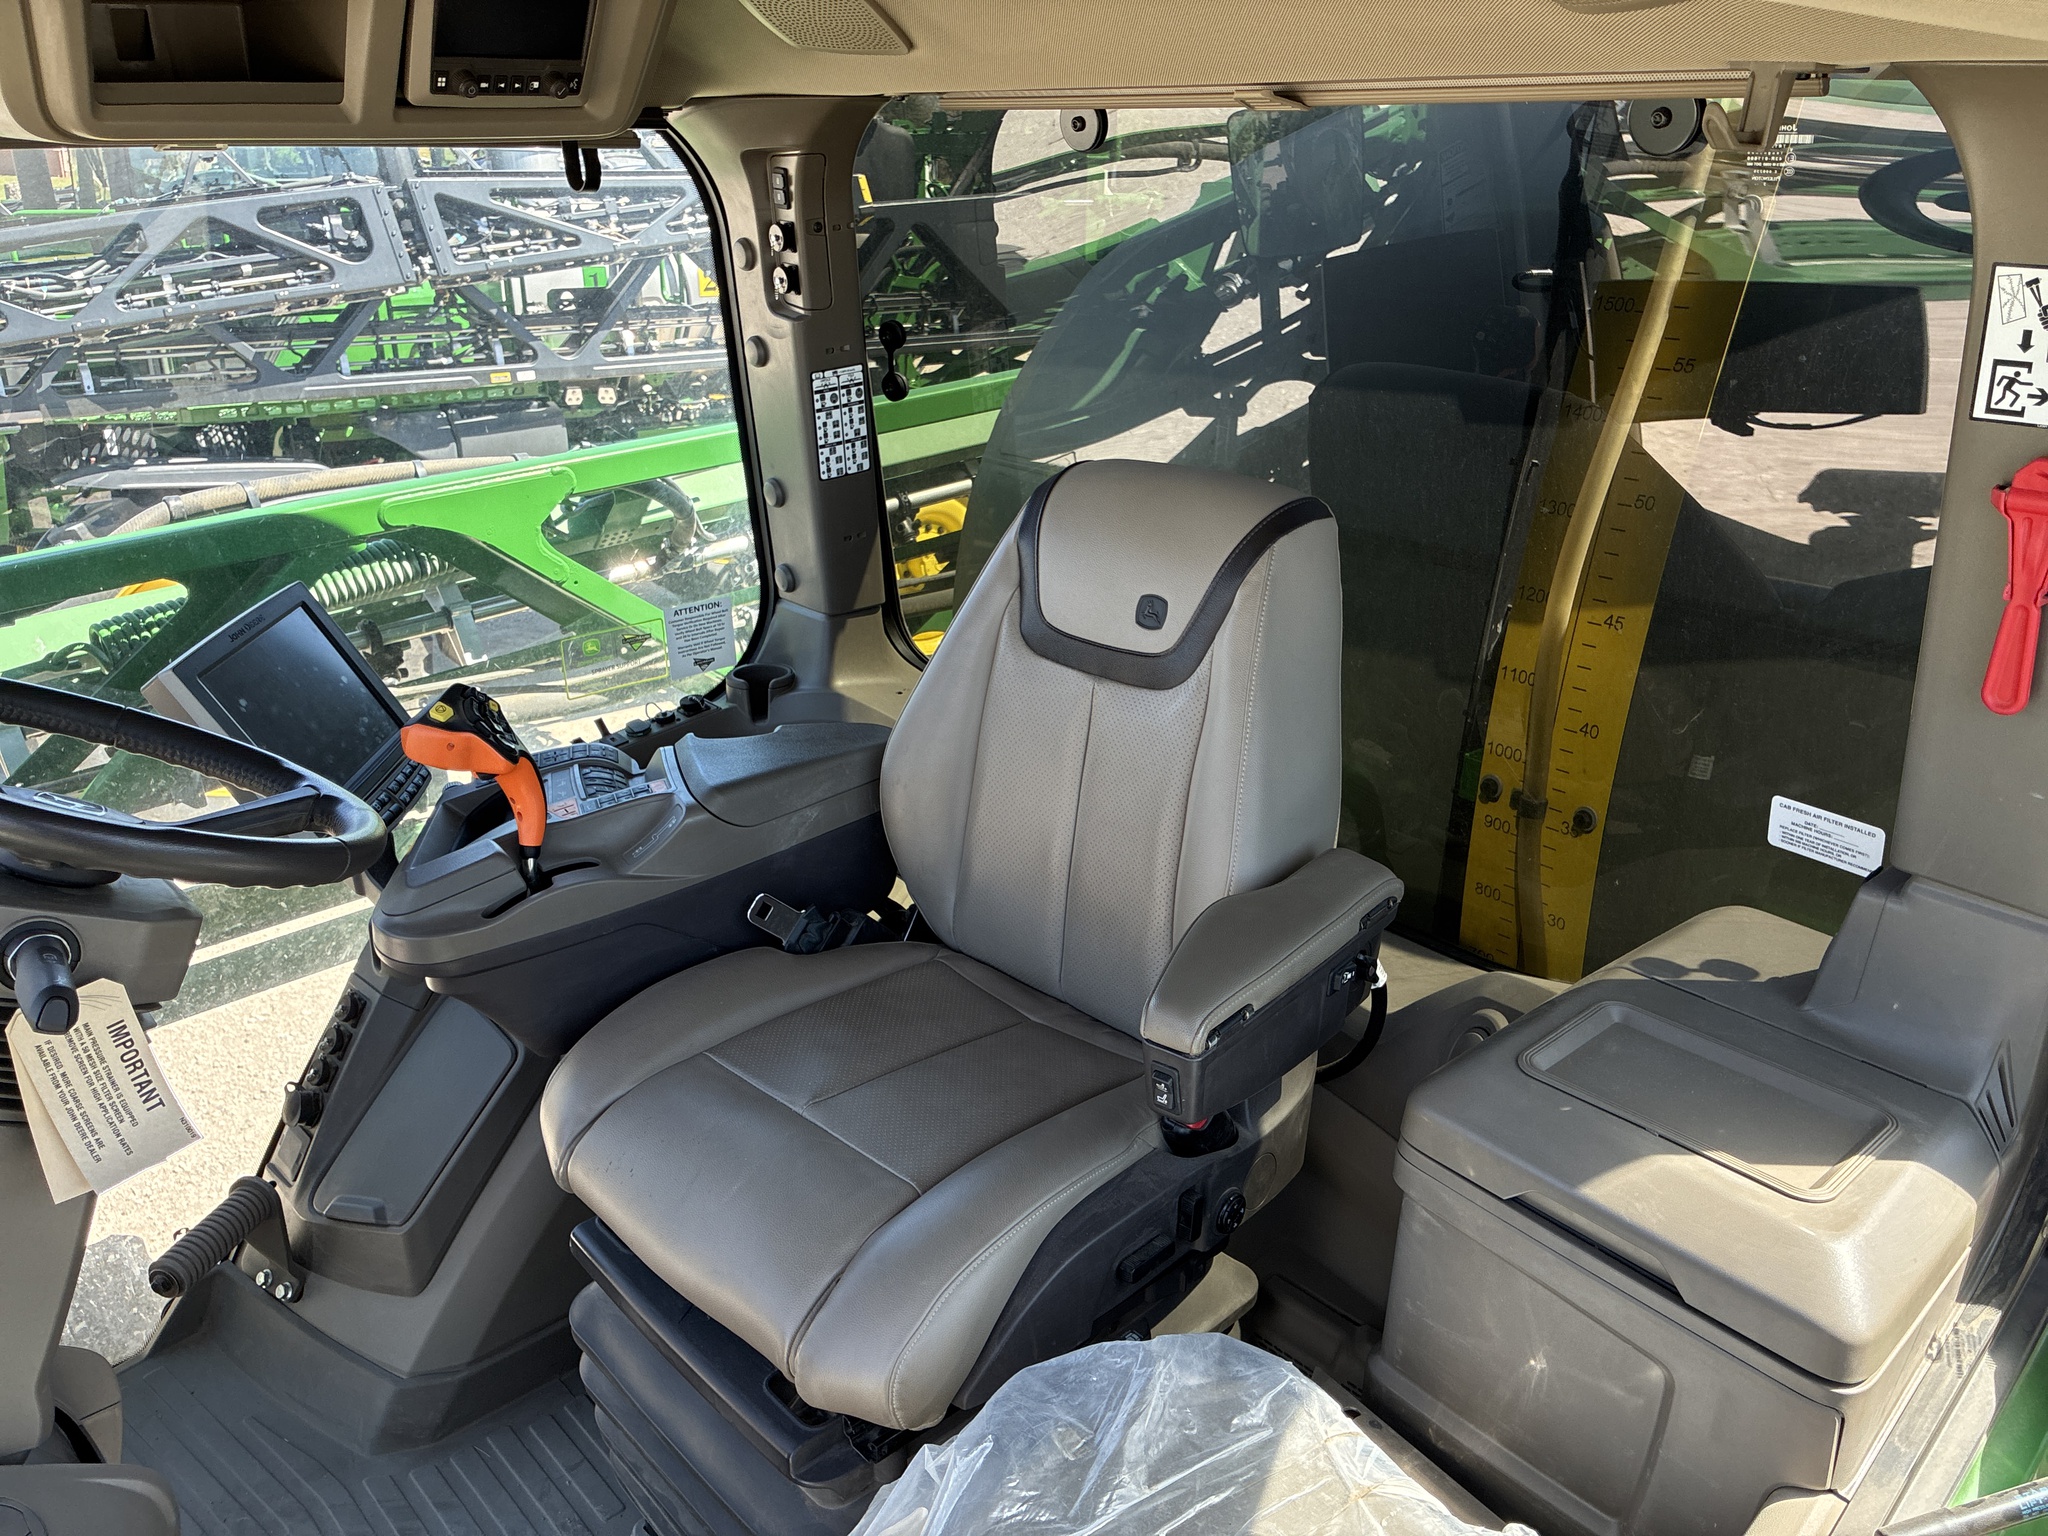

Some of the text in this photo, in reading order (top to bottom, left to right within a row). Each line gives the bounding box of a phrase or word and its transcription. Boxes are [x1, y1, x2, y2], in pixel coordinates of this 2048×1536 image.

[1597, 296, 1635, 313] 1500
[1673, 357, 1696, 373] 55
[1566, 403, 1602, 421] 1400
[1633, 494, 1656, 511] 50
[674, 601, 722, 617] ATTENTION:
[1603, 614, 1626, 631] 45
[228, 627, 246, 643] JOHN
[1502, 665, 1535, 687] 1100
[1579, 722, 1599, 739] 40
[1488, 741, 1522, 763] 1000
[1484, 814, 1511, 834] 900
[1793, 807, 1811, 817] FRESH
[1824, 817, 1843, 827] FILTER
[1844, 824, 1876, 838] INSTALLED
[1475, 882, 1501, 900] 800
[1547, 914, 1566, 930] 30
[73, 1026, 84, 1042] WITH
[82, 1046, 90, 1054] 50
[85, 1053, 97, 1070] MESH
[106, 1019, 166, 1112] IMPORTANT
[82, 1022, 94, 1037] MAIN
[89, 1036, 107, 1066] PRESSURE
[102, 1065, 120, 1093] STRAINER
[119, 1099, 139, 1127] EQUIPPED
[93, 1069, 104, 1083] SIZE
[46, 1046, 64, 1072] DESIRED,
[60, 1071, 73, 1089] MORE
[68, 1088, 84, 1111] COARSE
[80, 1111, 98, 1137] SCREENS
[94, 1137, 105, 1150] ARE
[99, 1082, 113, 1102] FILTER
[34, 1045, 102, 1163] AVAILABLE FROM YOUR JOHN DEERE DEALER
[74, 1053, 89, 1076] SCREEN
[84, 1075, 95, 1088] FOR
[90, 1087, 102, 1102] HIGH
[98, 1102, 122, 1138] APPLICATION
[118, 1138, 133, 1156] RATES
[109, 1101, 125, 1124] SCREEN
